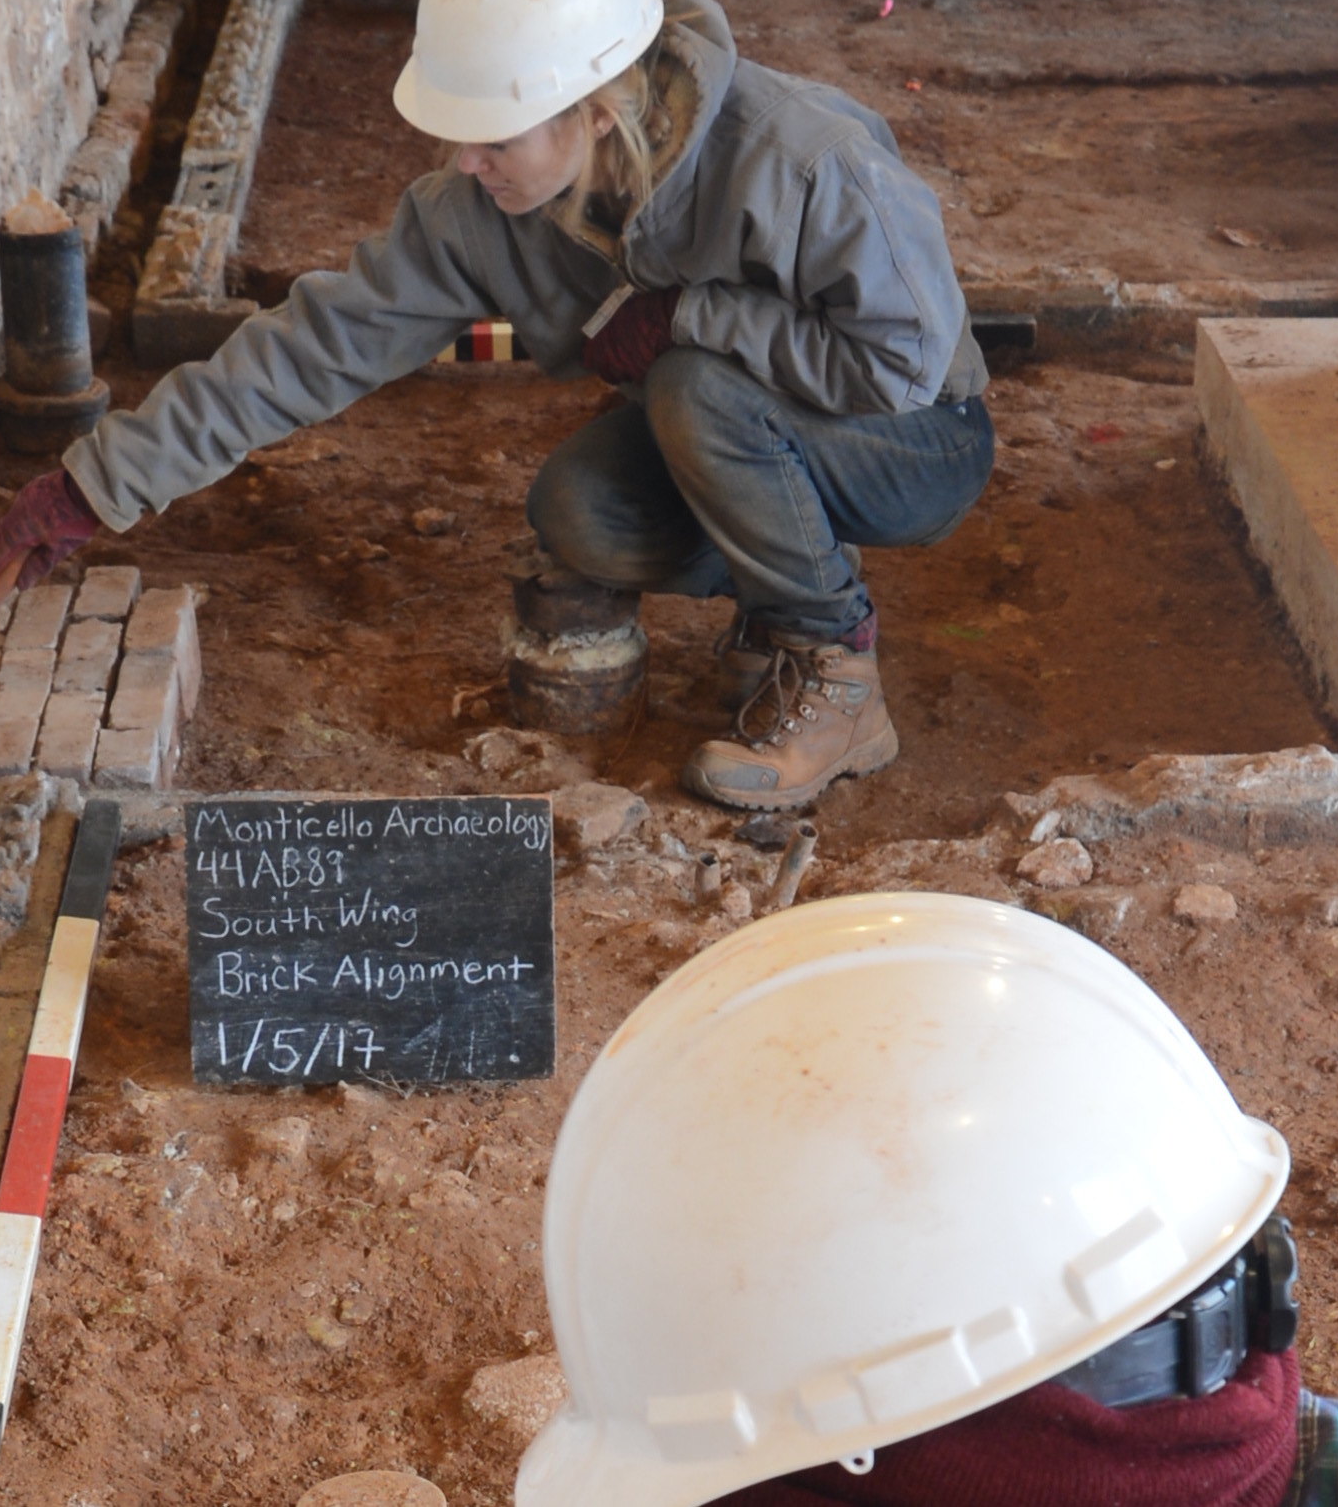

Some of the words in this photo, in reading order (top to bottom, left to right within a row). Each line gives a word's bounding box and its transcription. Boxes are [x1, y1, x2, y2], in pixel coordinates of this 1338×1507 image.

[195, 807, 372, 842] Monticello
[383, 803, 550, 851] Archaeology
[199, 897, 324, 938] South
[339, 887, 417, 947] Wing
[217, 952, 317, 995] Brick
[333, 955, 534, 1000] Alignment
[219, 1018, 385, 1075] 1/5/17
